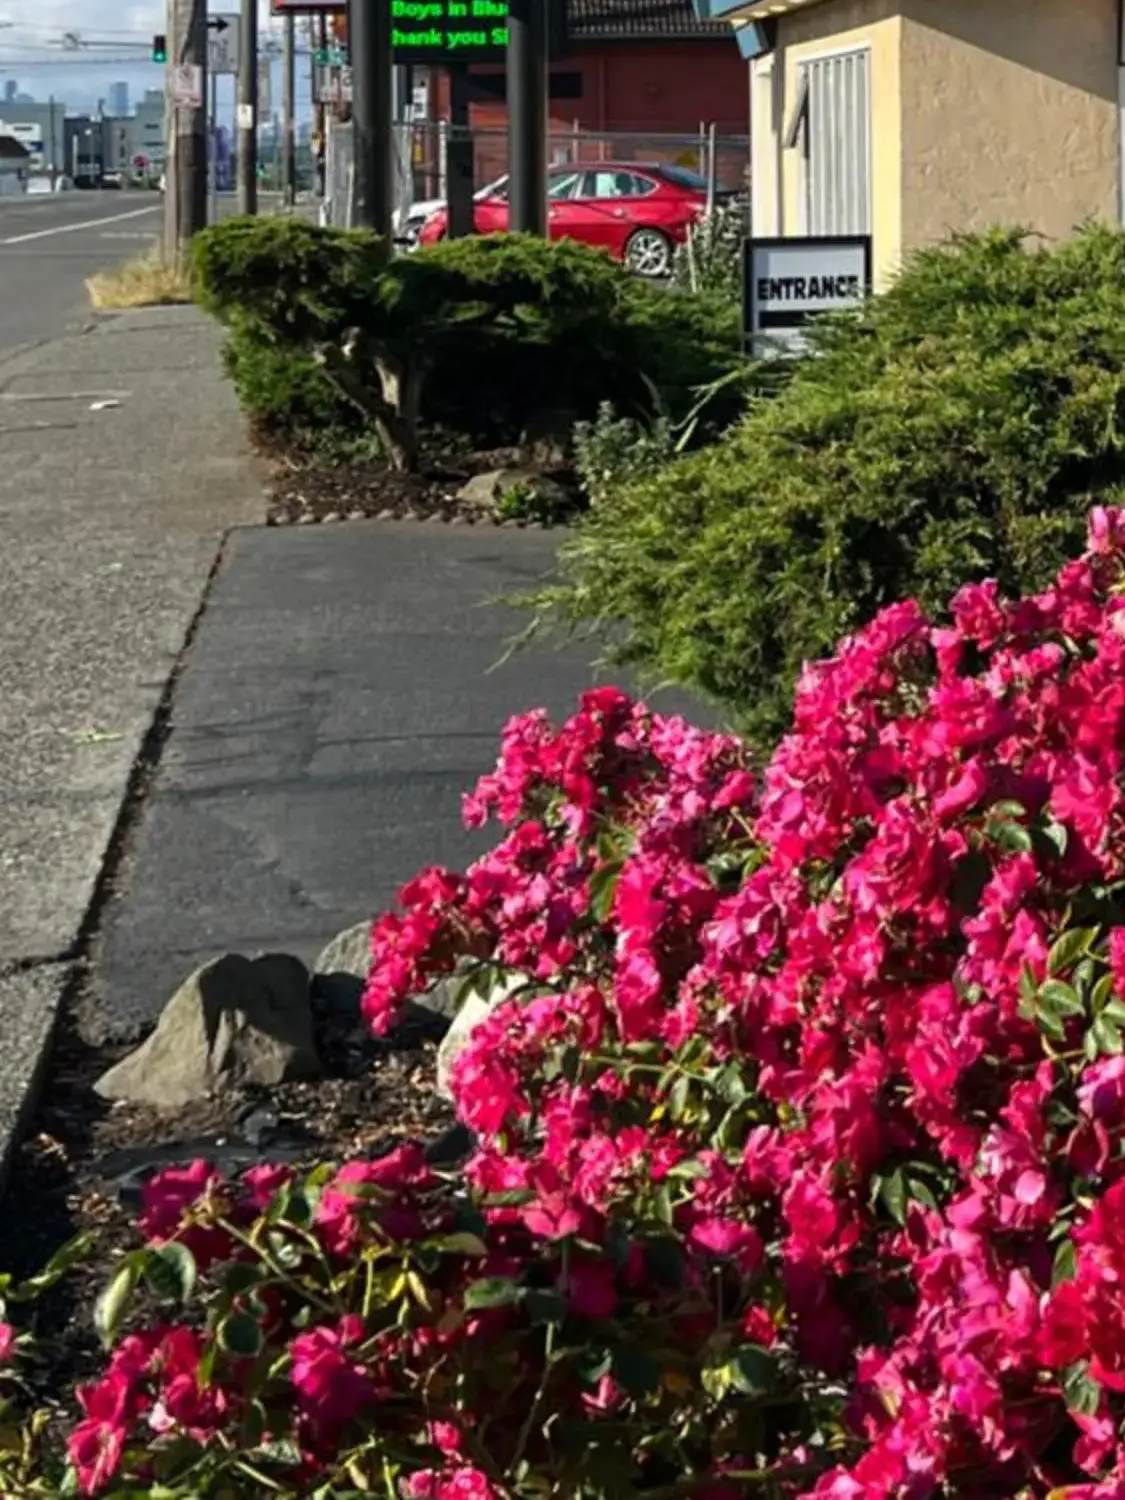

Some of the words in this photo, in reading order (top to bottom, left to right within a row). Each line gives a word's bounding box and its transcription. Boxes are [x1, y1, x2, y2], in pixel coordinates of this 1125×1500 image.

[391, 0, 443, 20] Boys
[391, 28, 442, 46] hank
[446, 30, 487, 49] you
[757, 275, 859, 301] ENTRANCE
